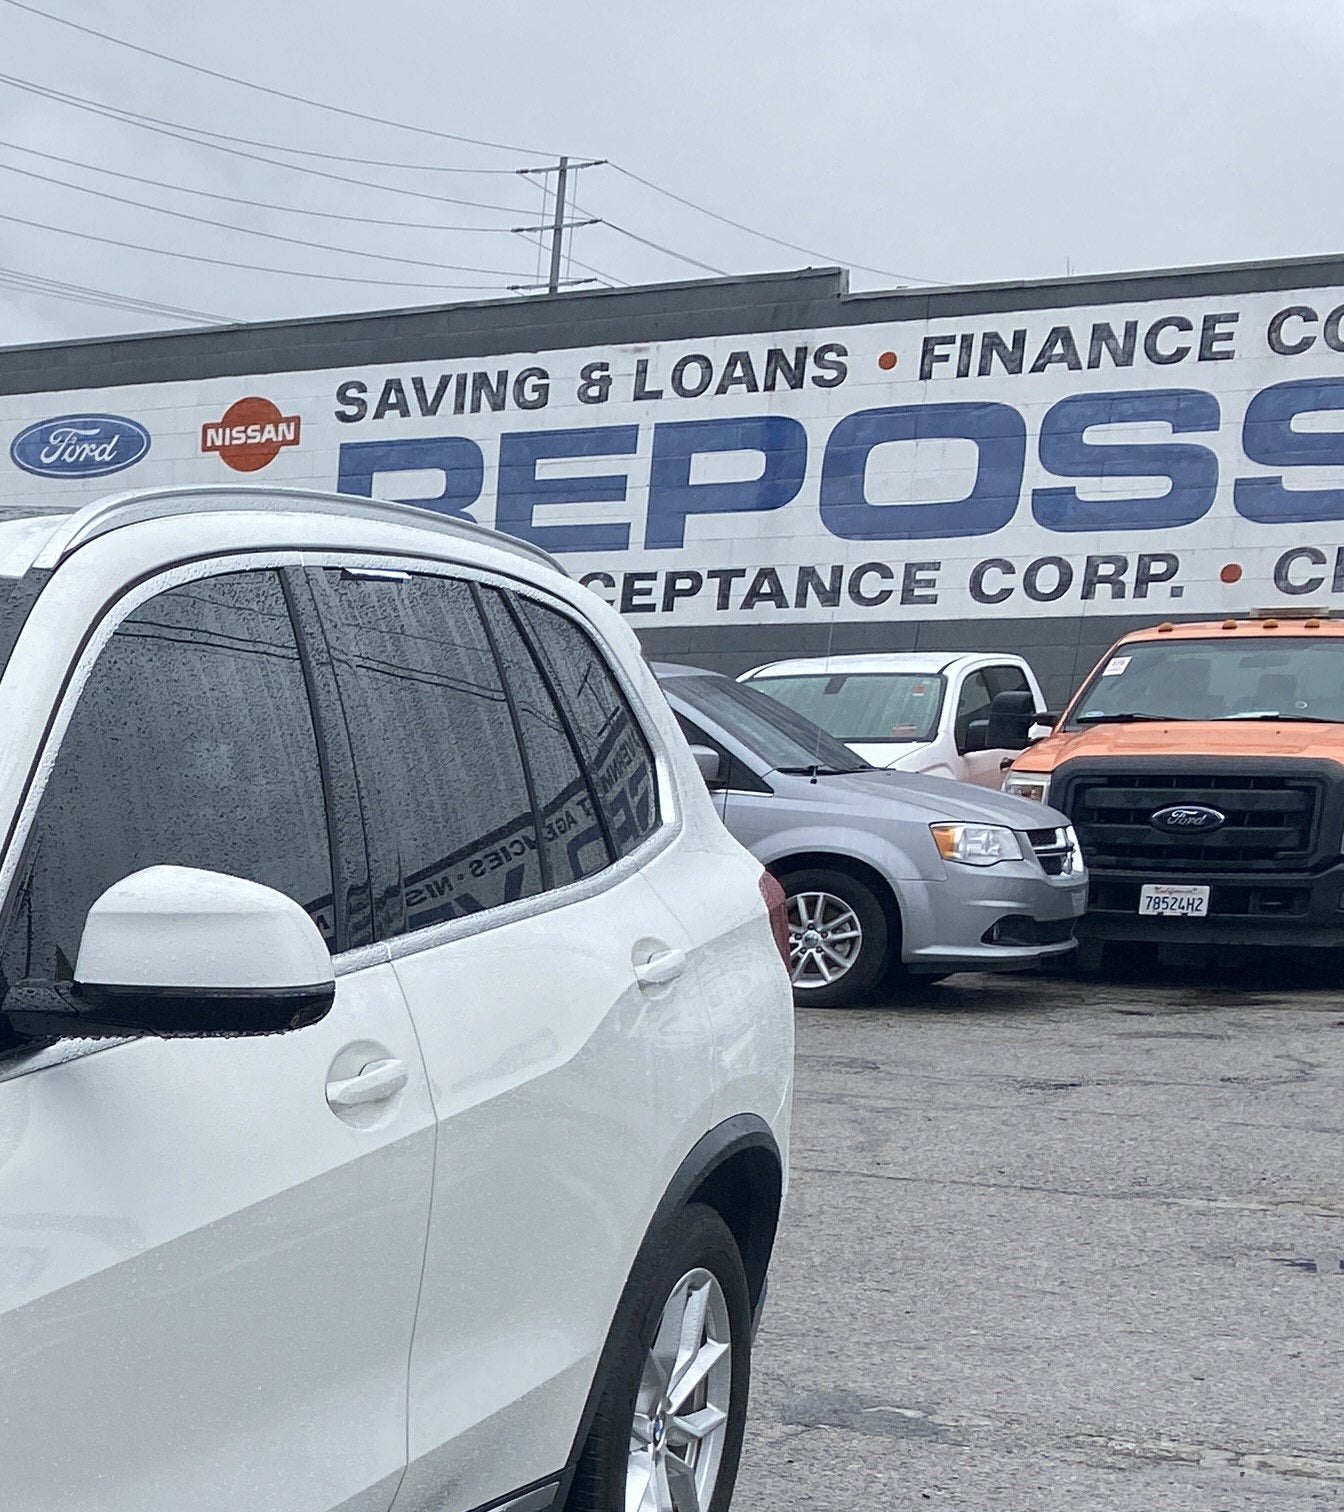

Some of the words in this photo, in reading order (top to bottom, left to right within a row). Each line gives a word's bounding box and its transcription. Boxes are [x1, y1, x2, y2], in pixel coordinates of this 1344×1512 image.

[334, 366, 550, 424] SAVING
[577, 361, 613, 404] &
[632, 342, 849, 402] LOANS
[918, 311, 1241, 382] FINANCE
[39, 427, 120, 464] Ford
[205, 419, 296, 449] NISSAN
[336, 376, 1344, 554] REPOSS
[969, 553, 1185, 605] CORP.
[1274, 546, 1344, 595] C
[1166, 808, 1208, 827] Ford
